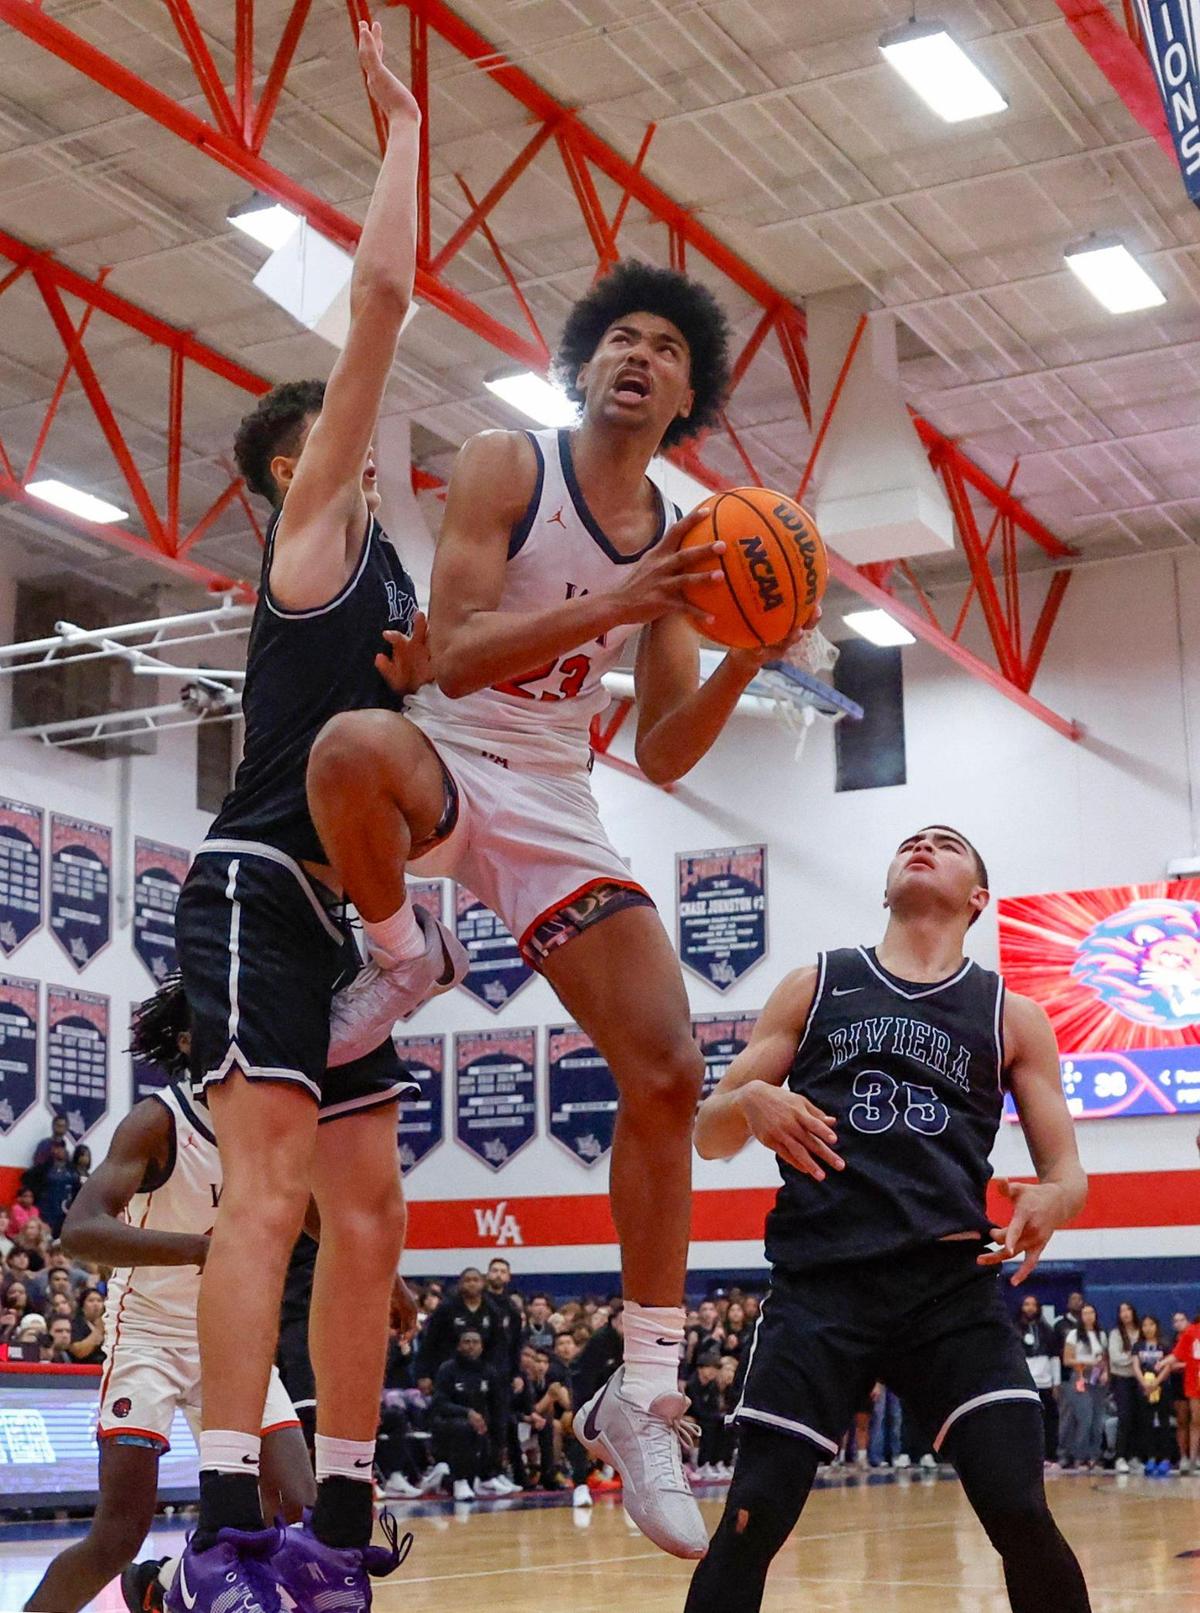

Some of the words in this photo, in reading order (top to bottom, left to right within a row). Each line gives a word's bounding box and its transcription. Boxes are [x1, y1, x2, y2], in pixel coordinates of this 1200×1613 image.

[739, 536, 785, 612] NCAA
[827, 1016, 972, 1093] RIVIERA
[849, 1069, 951, 1136] 35
[473, 1200, 524, 1246] WA
